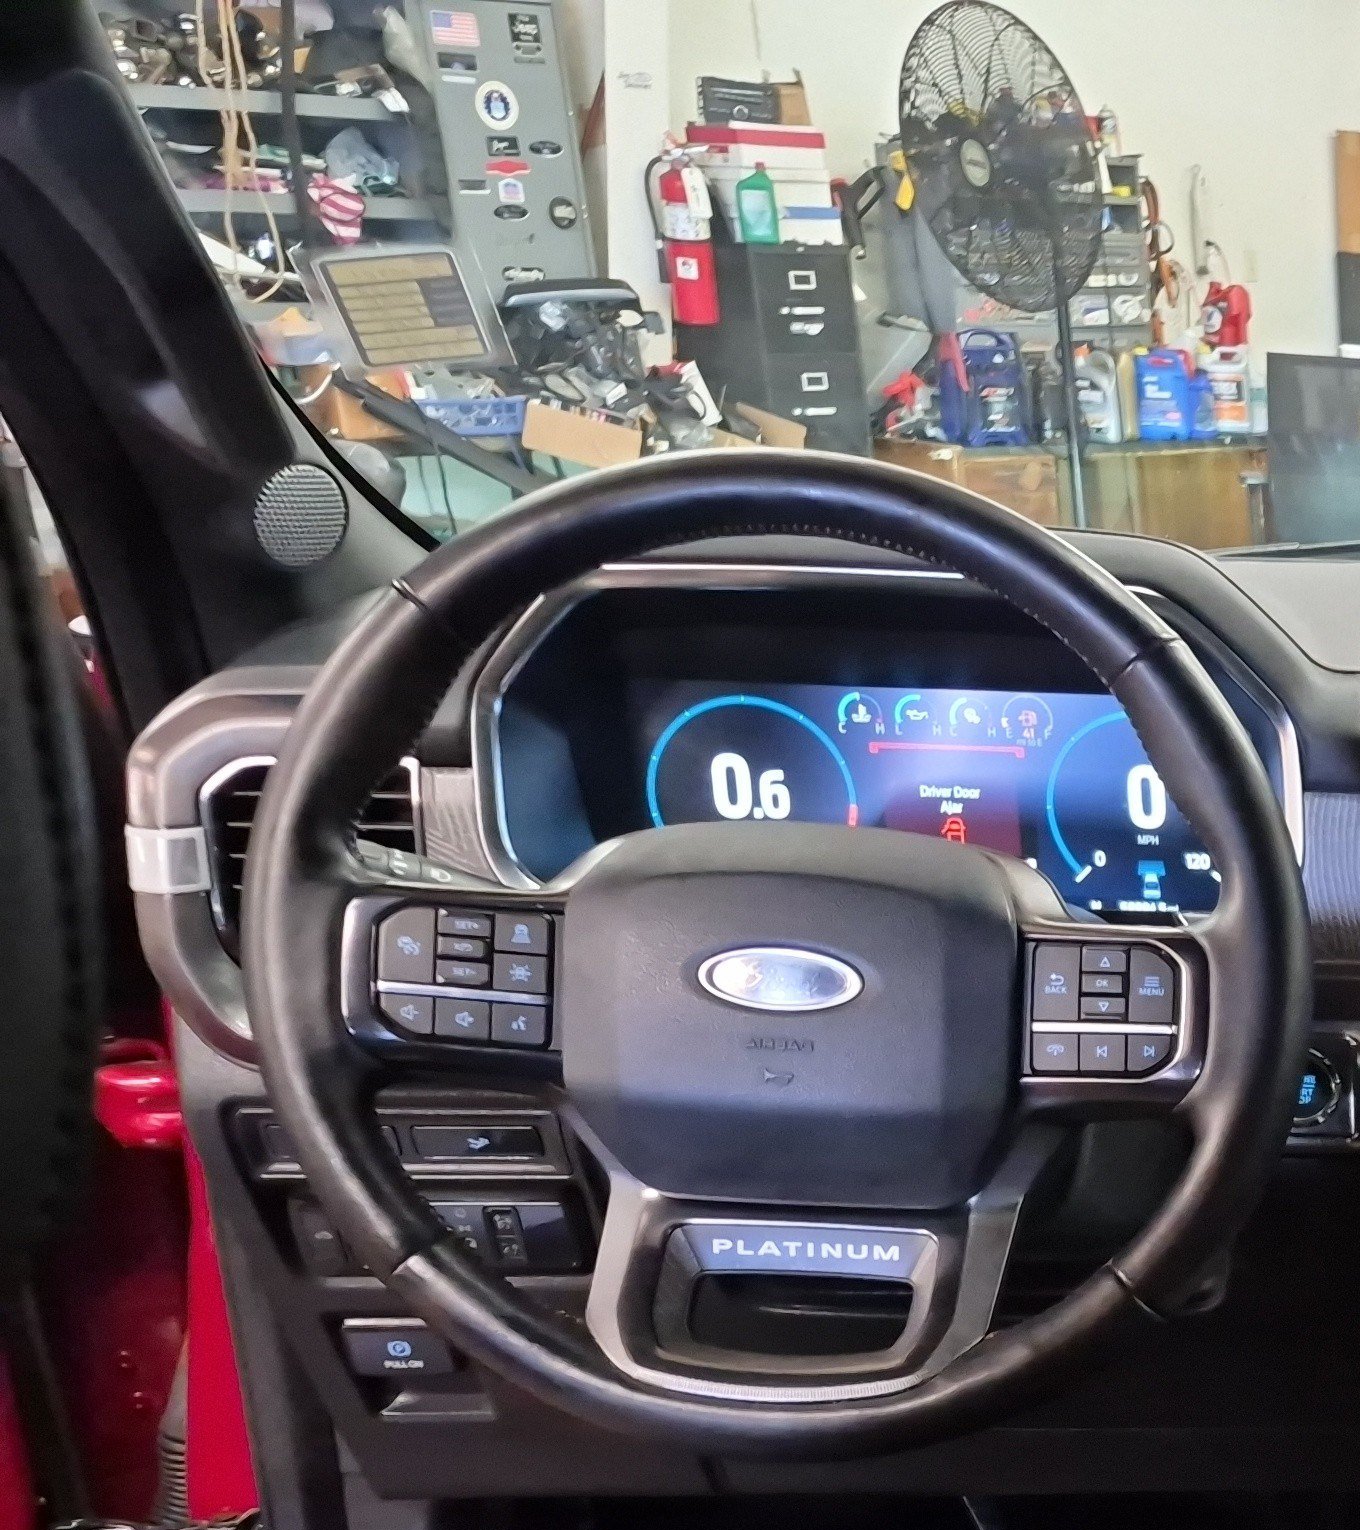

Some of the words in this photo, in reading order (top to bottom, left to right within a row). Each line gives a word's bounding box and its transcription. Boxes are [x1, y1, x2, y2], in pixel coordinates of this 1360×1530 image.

[875, 722, 885, 735] H
[1022, 728, 1035, 739] 41
[710, 752, 791, 820] 0.6
[919, 784, 952, 799] Driver
[953, 785, 981, 800] Door
[1137, 835, 1160, 846] MPH
[1093, 850, 1107, 868] 0
[1183, 852, 1211, 870] 120
[1044, 984, 1067, 995] BACK
[1095, 978, 1109, 988] OK
[1138, 986, 1165, 997] MENU
[711, 1238, 900, 1261] PLATINUM
